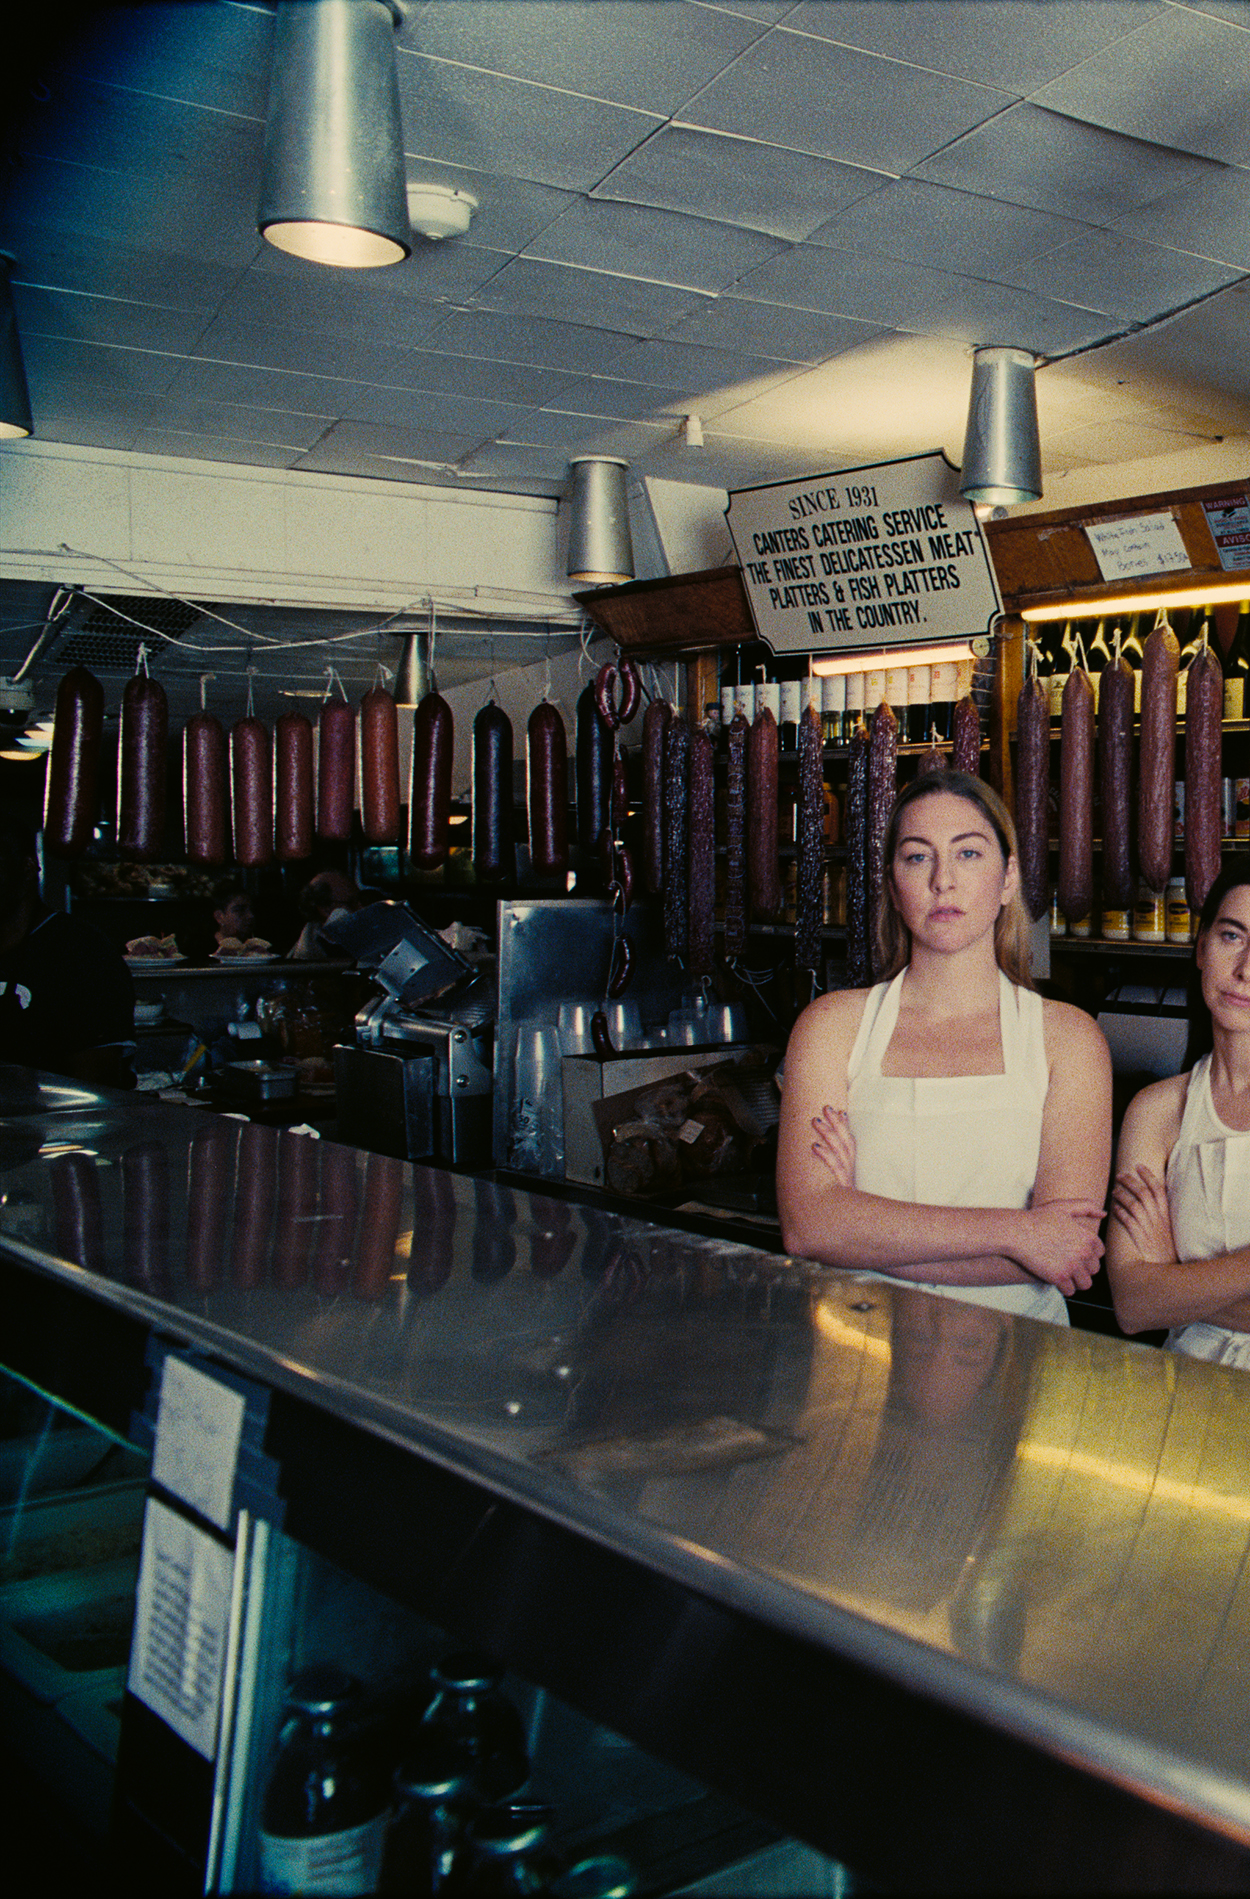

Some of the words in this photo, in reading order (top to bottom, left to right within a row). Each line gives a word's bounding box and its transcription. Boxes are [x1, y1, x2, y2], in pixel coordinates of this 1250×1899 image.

[788, 487, 840, 520] SINCE
[845, 485, 880, 508] 1931
[1205, 497, 1246, 509] WARNING
[753, 526, 810, 556] CANTERS
[812, 515, 879, 548] CATERING
[882, 503, 948, 537] SERVICE
[746, 562, 773, 585] THE
[775, 555, 818, 581] FINEST
[820, 539, 925, 577] DELICATESSEN
[928, 530, 976, 561] MEAT
[769, 582, 830, 610] PLATTERS
[834, 580, 846, 603] &
[847, 574, 882, 604] FISH
[885, 564, 961, 597] PLATTERS
[807, 610, 824, 634] IN
[826, 607, 854, 632] THE
[856, 599, 928, 630] COUNTRY.
